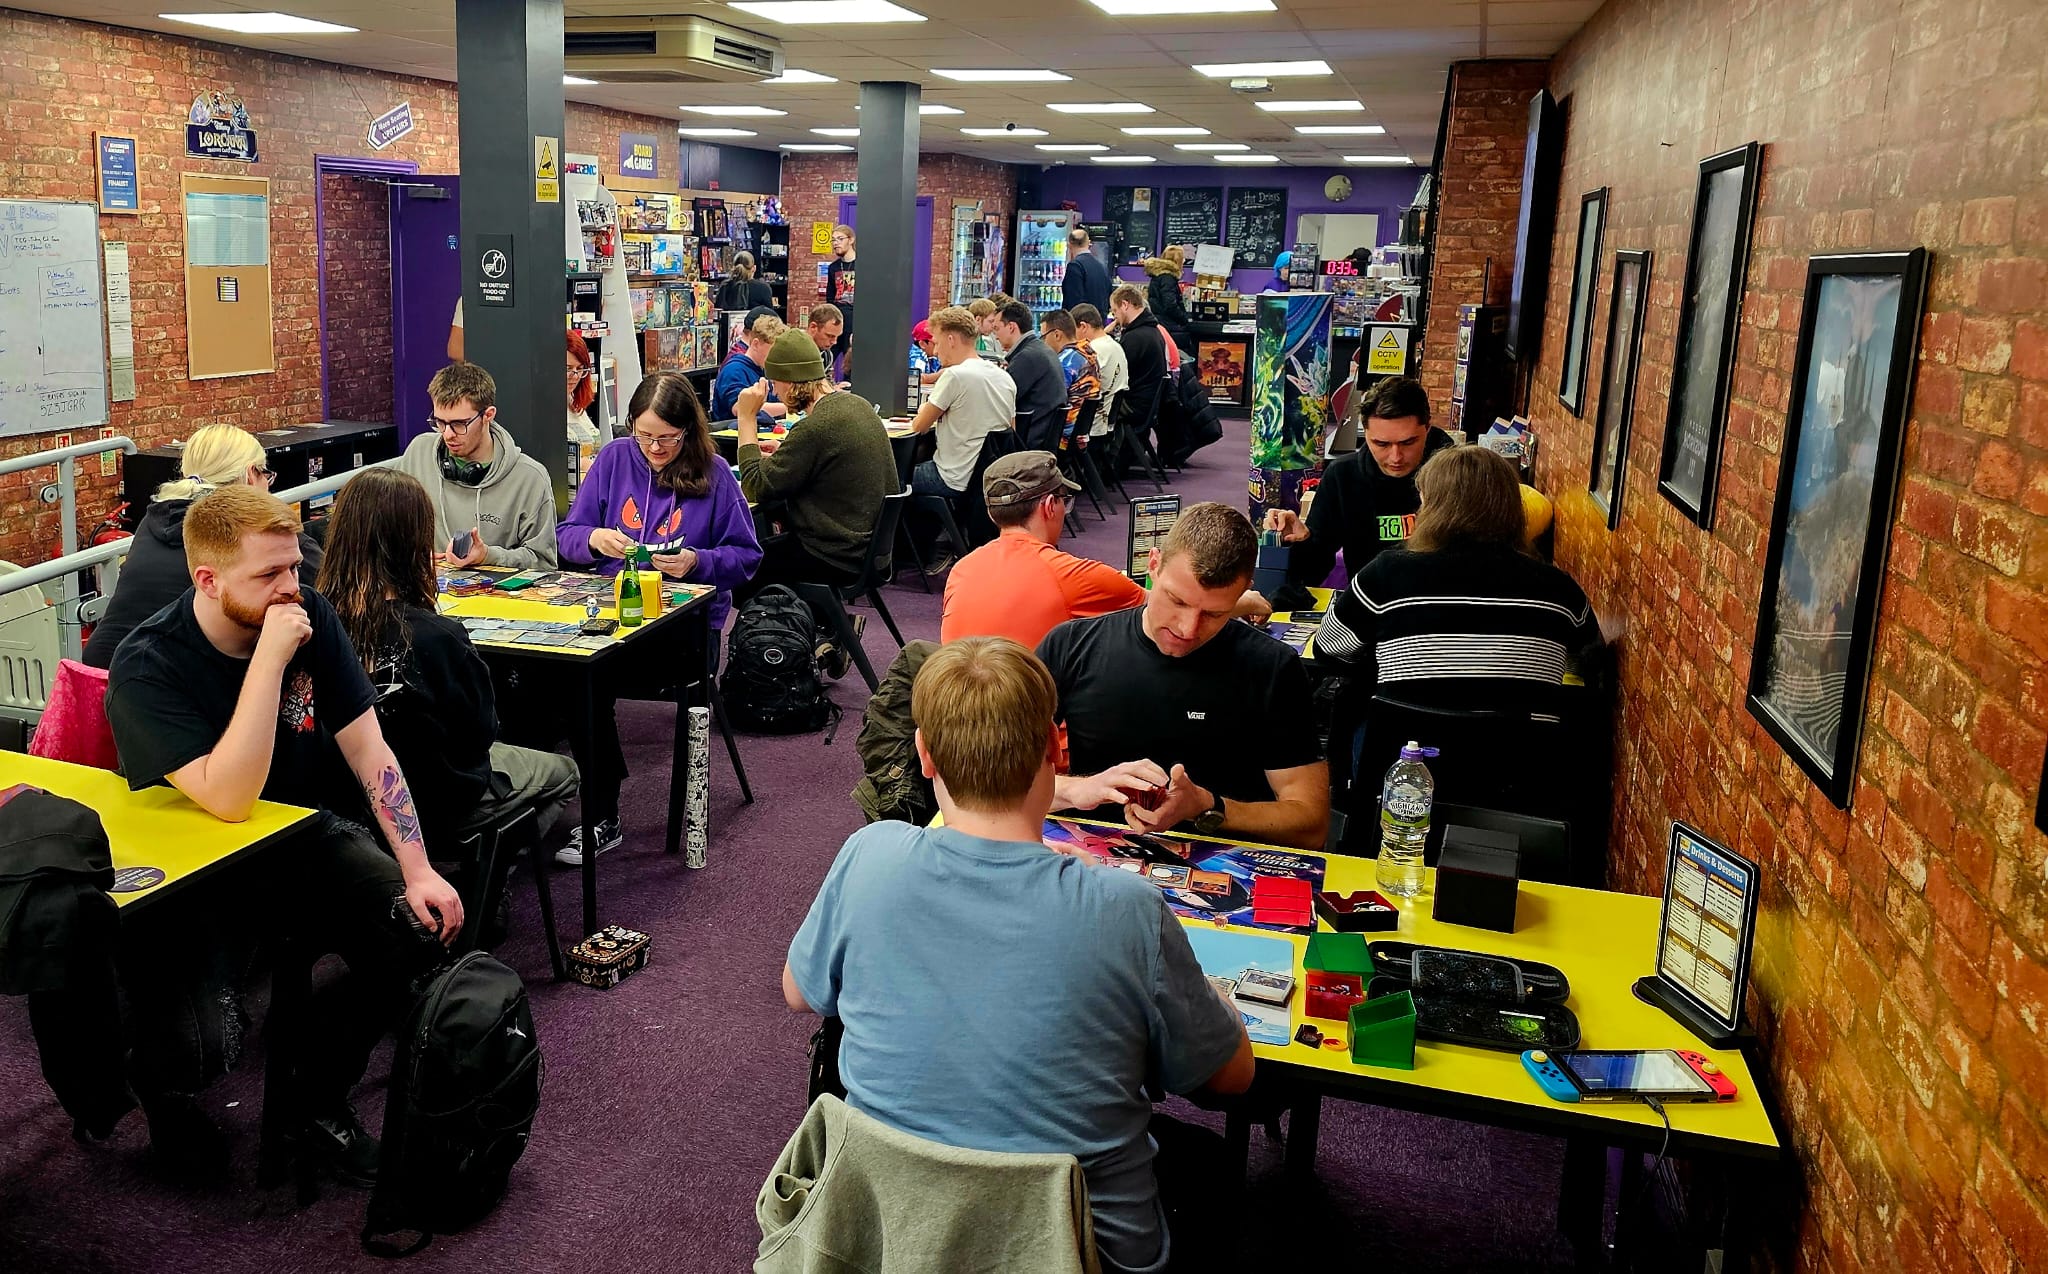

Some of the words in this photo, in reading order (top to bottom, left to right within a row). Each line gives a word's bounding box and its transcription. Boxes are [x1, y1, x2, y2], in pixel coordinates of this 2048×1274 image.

[382, 118, 409, 140] UPSTAIRS
[198, 131, 248, 152] LORCANA
[633, 144, 653, 158] BOARD
[634, 157, 653, 171] GAMES
[541, 183, 553, 191] CCTV
[1377, 350, 1399, 358] CCTV
[1372, 364, 1400, 372] operation
[1187, 711, 1205, 720] VANS
[1390, 801, 1424, 813] HIGHLAND
[1690, 845, 1711, 864] Drinks
[1710, 857, 1717, 868] &
[1717, 860, 1743, 884] Desserts
